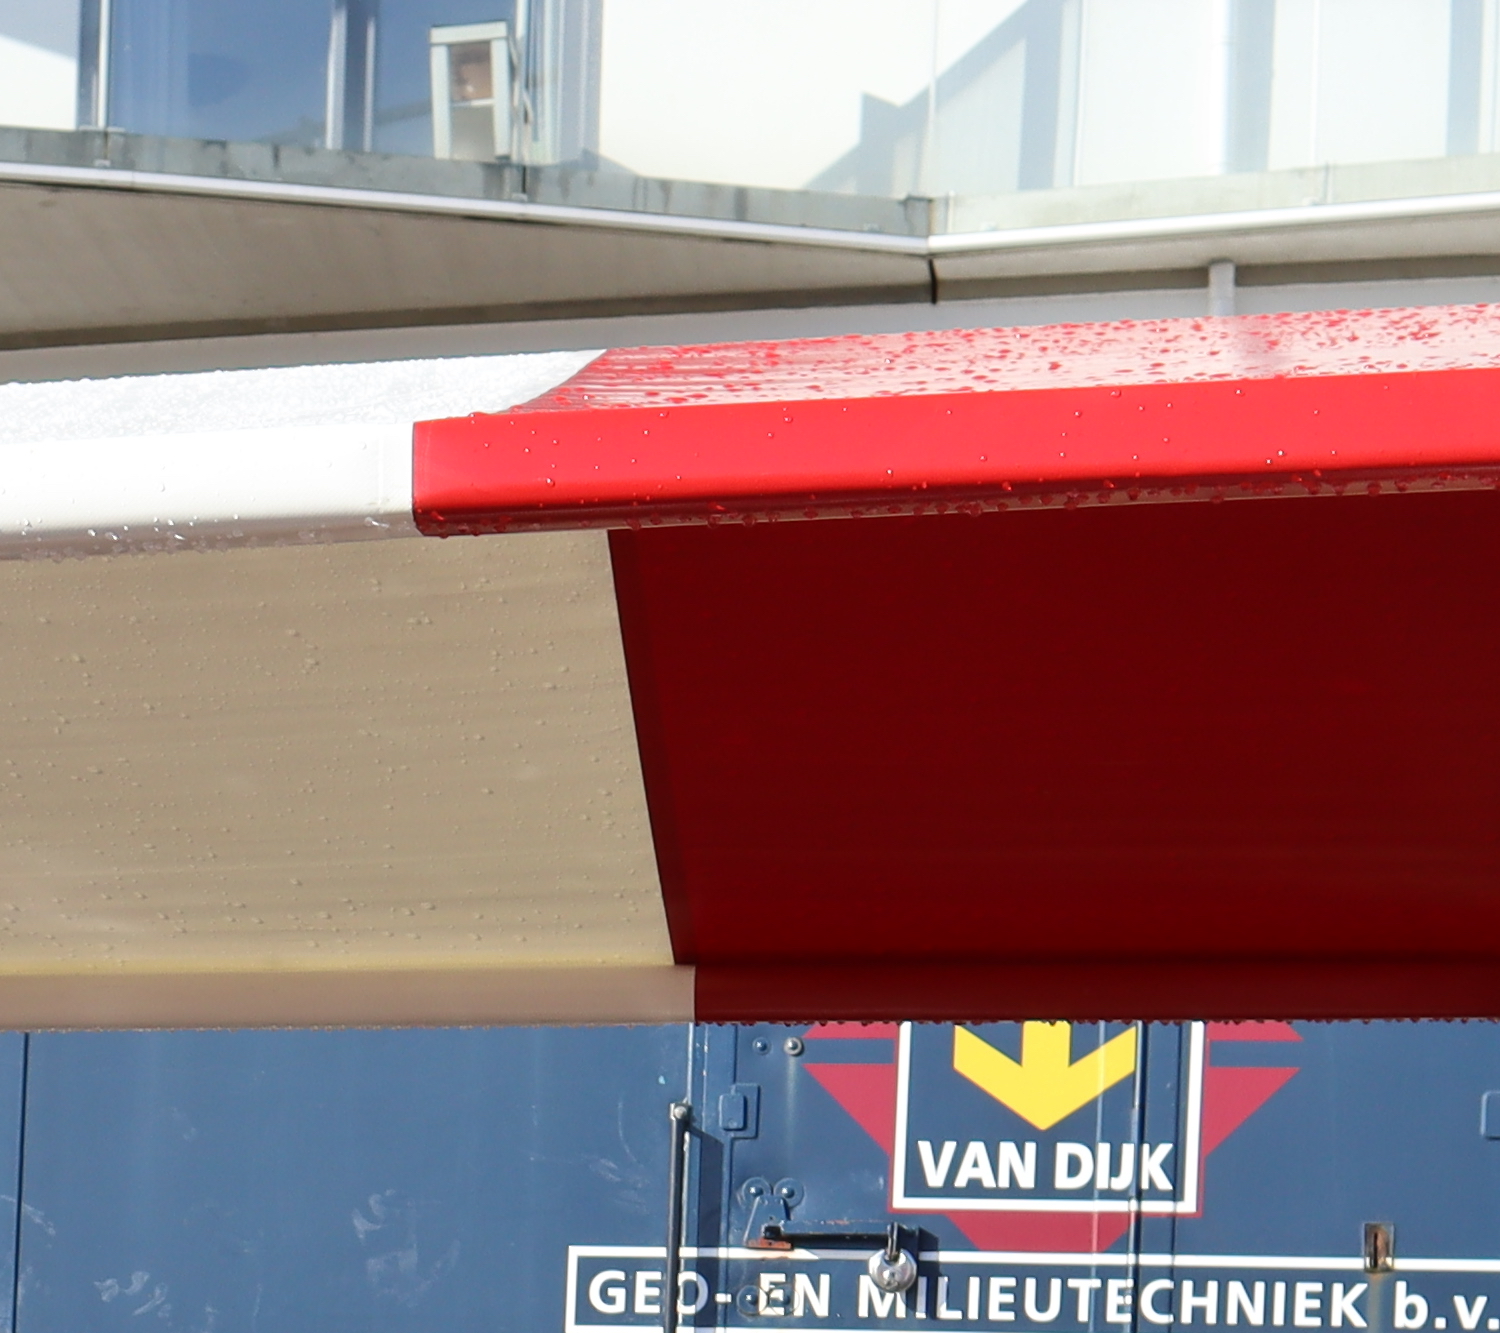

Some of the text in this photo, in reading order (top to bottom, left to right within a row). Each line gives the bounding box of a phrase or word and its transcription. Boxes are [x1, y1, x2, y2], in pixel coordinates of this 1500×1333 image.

[917, 1140, 1174, 1192] VAN DIJK
[758, 1272, 831, 1318] EN
[857, 1274, 1369, 1329] MILIEUTECHNIEK
[1394, 1281, 1500, 1331] b.v.
